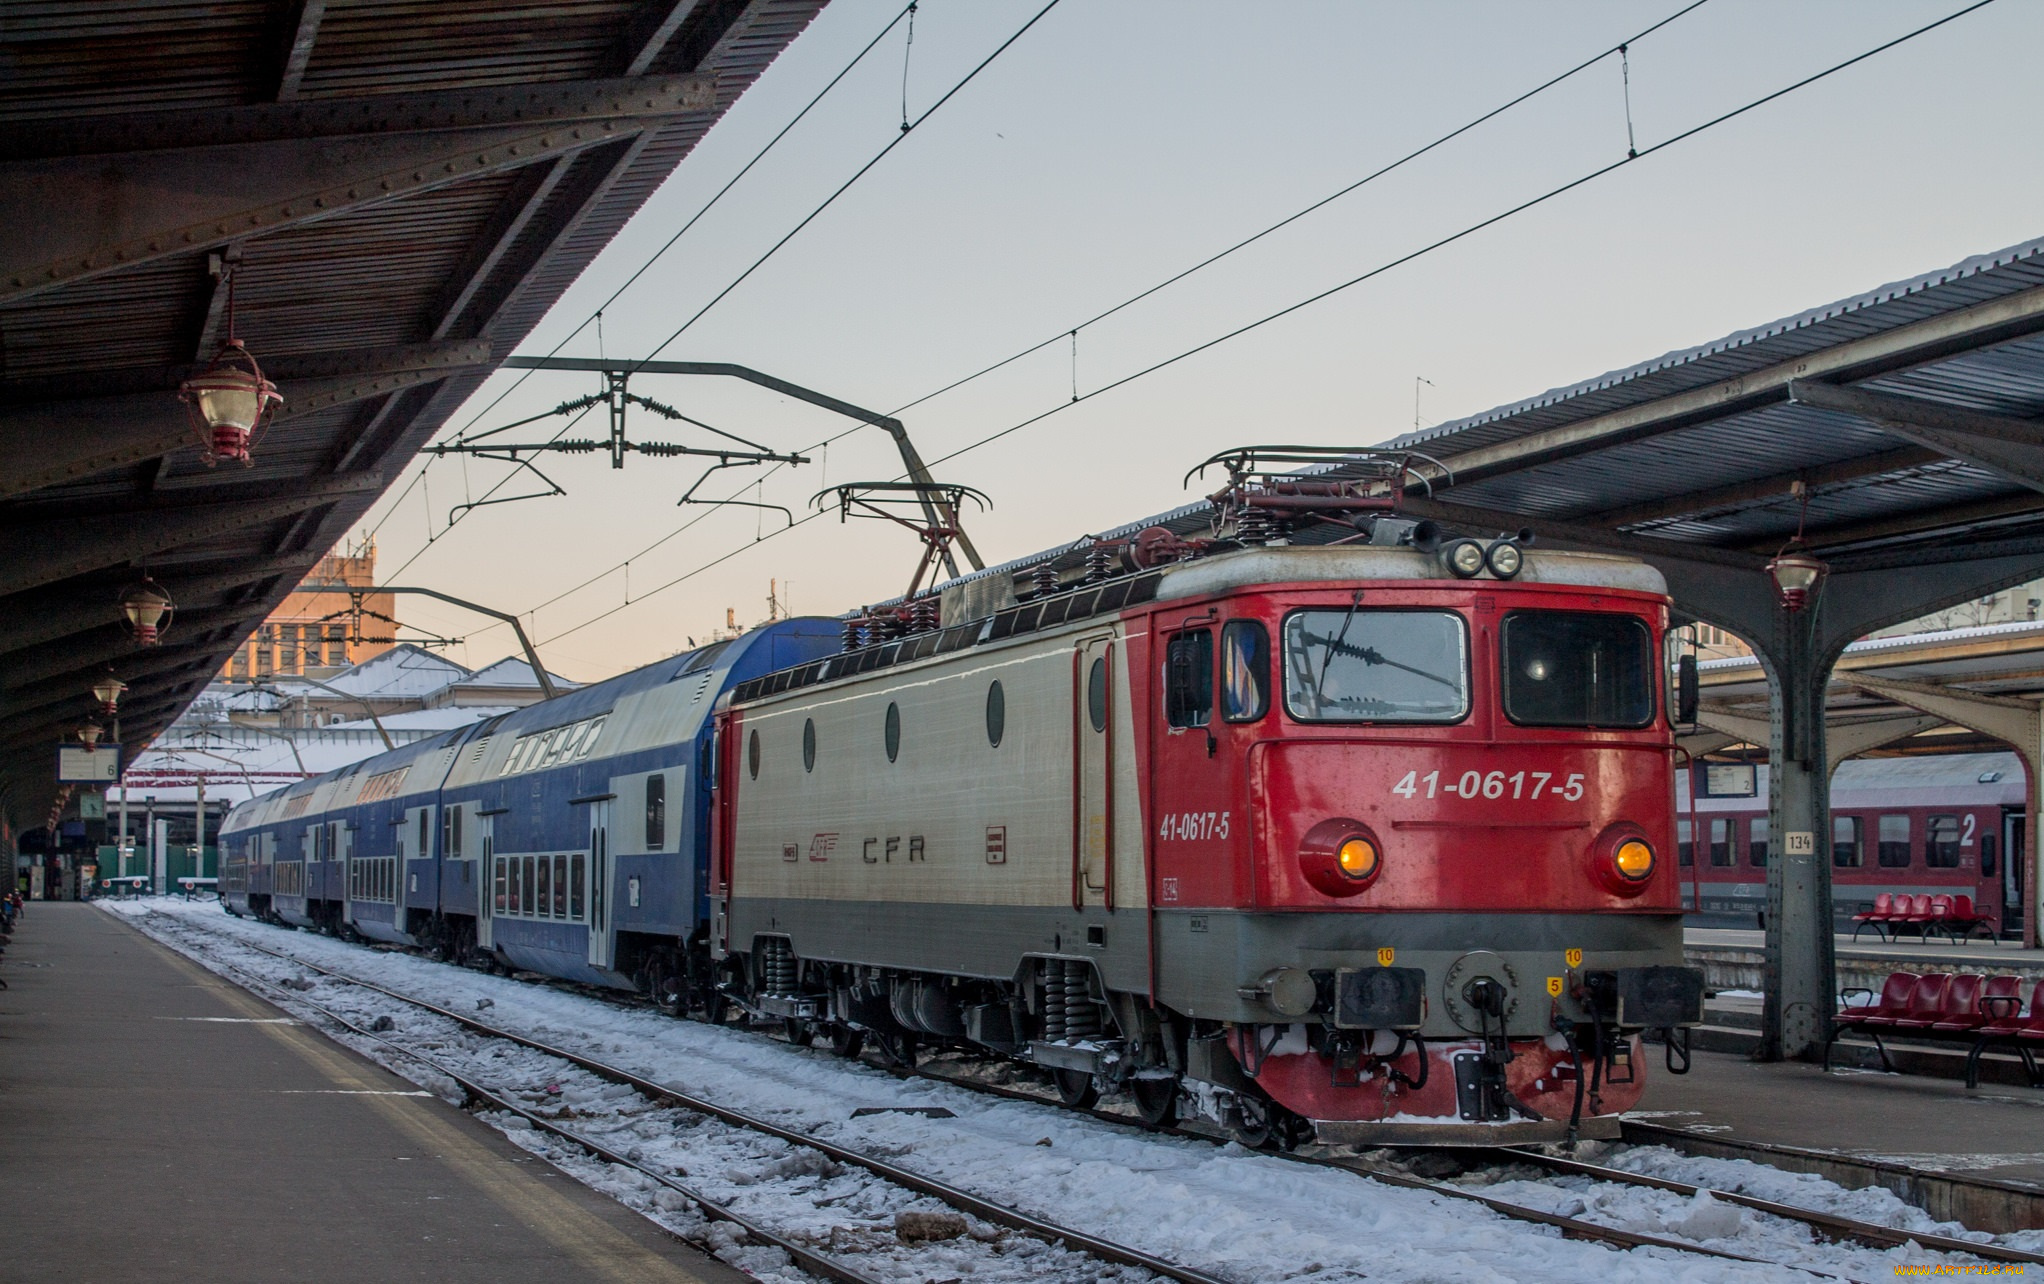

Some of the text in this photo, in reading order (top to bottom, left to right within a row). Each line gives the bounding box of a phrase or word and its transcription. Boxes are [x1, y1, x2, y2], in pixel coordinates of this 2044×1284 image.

[108, 765, 115, 775] 6
[1392, 770, 1585, 801] 41-0617-5
[1744, 781, 1750, 790] 2
[1160, 811, 1230, 841] 41-0617-5
[1960, 813, 1976, 846] 2
[1790, 835, 1810, 849] 134
[863, 835, 925, 863] CFR
[1378, 950, 1393, 961] 10
[1567, 950, 1581, 962] 10
[1551, 980, 1559, 992] 5
